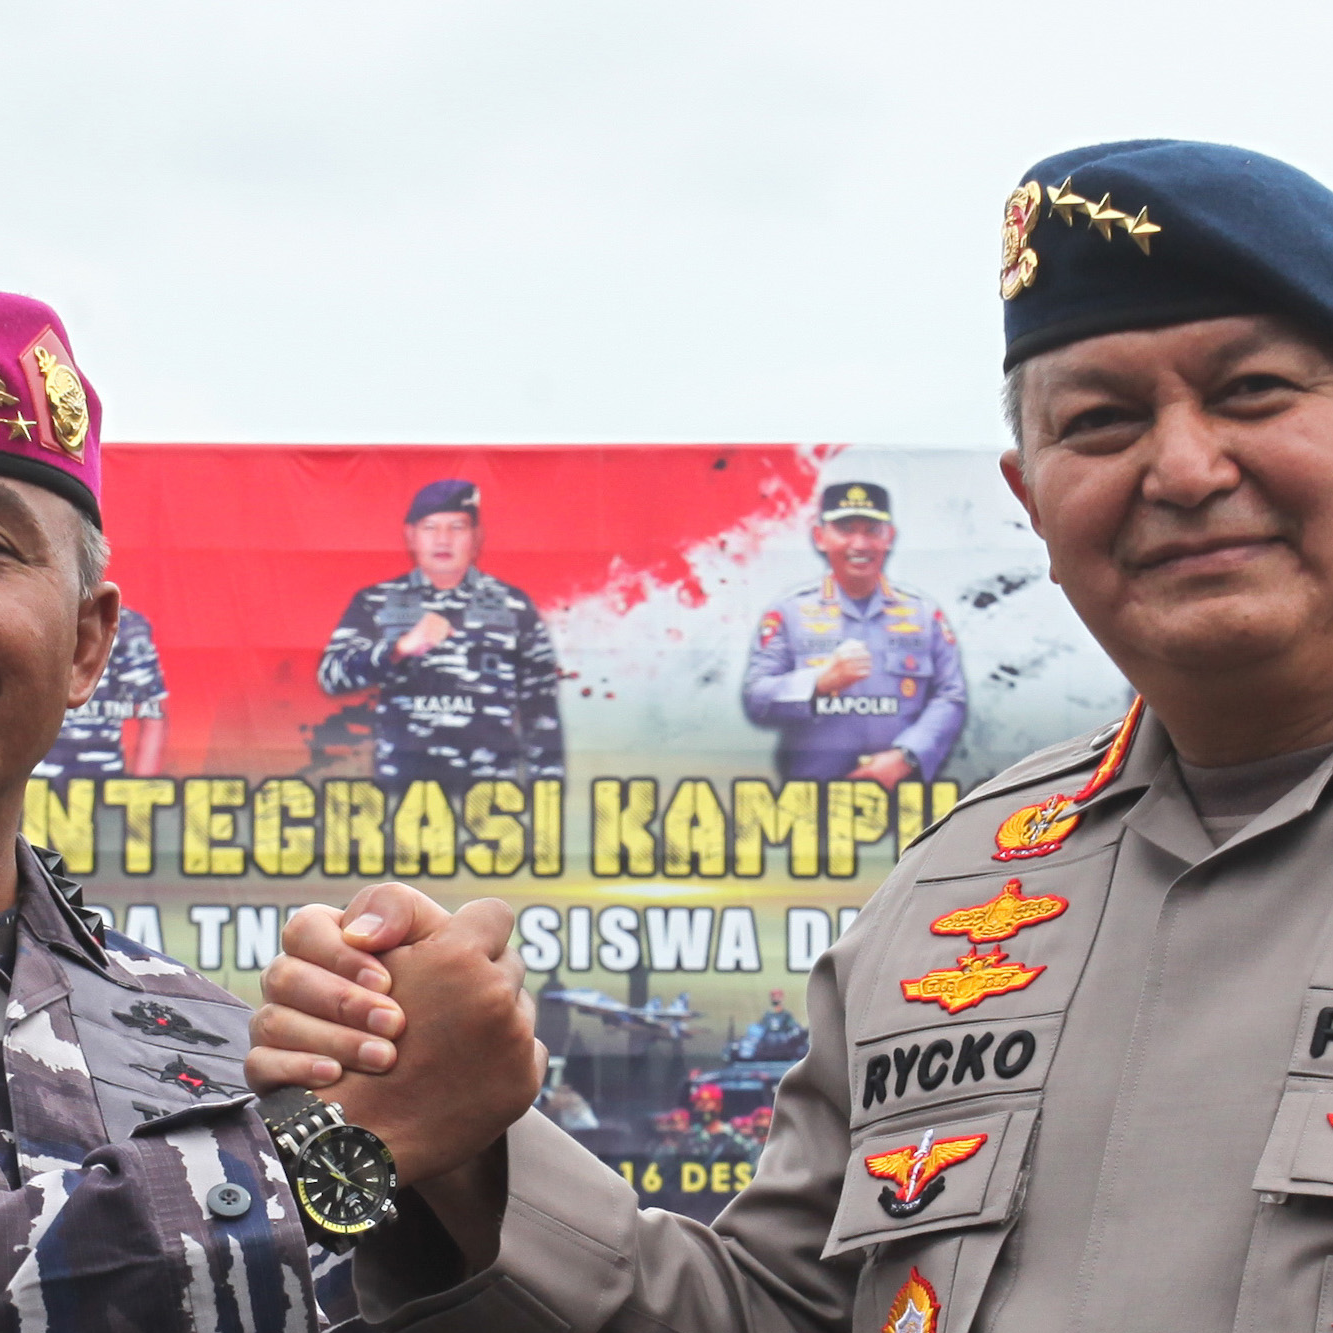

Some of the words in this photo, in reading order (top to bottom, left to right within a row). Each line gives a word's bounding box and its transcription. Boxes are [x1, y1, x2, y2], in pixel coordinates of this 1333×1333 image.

[136, 701, 164, 718] AL
[414, 696, 475, 714] KASAL
[816, 697, 898, 715] KAPOLRI
[520, 906, 760, 972] SISWA
[862, 1029, 1036, 1109] RYCKO
